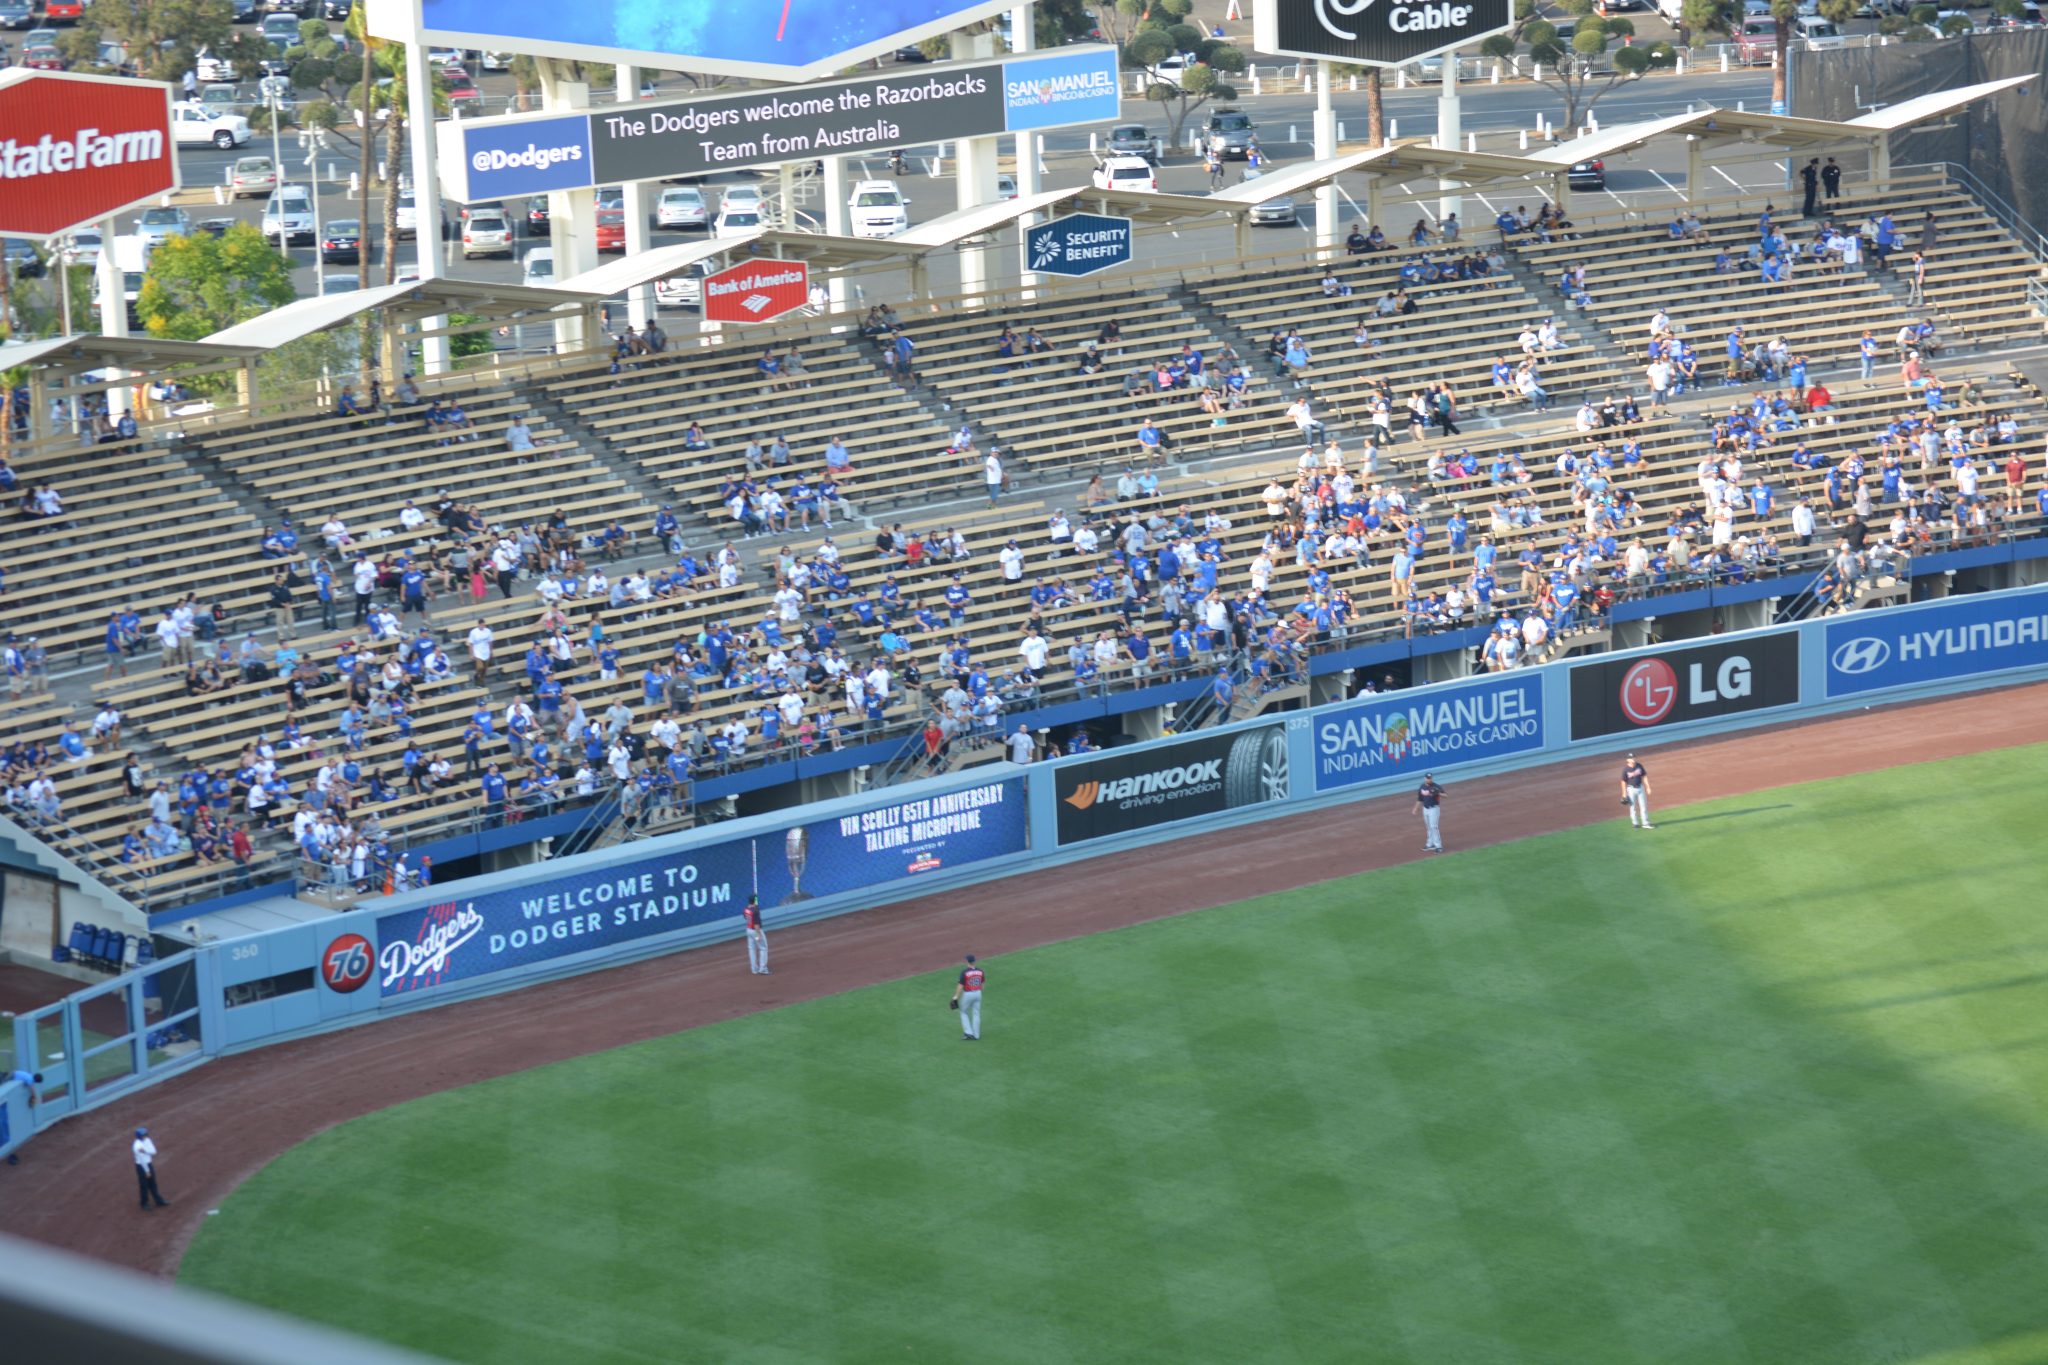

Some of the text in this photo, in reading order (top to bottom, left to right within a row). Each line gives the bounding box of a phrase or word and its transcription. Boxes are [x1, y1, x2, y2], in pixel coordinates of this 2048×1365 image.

[1388, 2, 1468, 33] Cable
[605, 73, 987, 139] The Dodgers welcome the Razorbacks
[1007, 71, 1114, 98] SAN MANUEL
[1008, 96, 1040, 108] INDIAN
[1051, 91, 1078, 103] BINGO
[1086, 86, 1115, 98] CASINO
[472, 144, 583, 172] @Dodgers
[699, 119, 900, 163] Team from Australia
[1066, 228, 1127, 246] SECURITY
[708, 270, 803, 296] Bank of America
[1900, 614, 2048, 662] HYUNDAI
[1689, 655, 1752, 705] LG
[1289, 717, 1310, 731] 375
[1320, 688, 1537, 755] SAN MANUEL
[1323, 718, 1538, 775] INDIAN BINGO & CASINO
[839, 783, 1004, 837] VIN SCULLY 65TH ANNIVERSARY
[1119, 781, 1222, 810] driving emotion
[864, 809, 982, 853] TALKING MICROPHONE
[521, 864, 699, 920] WELCOME TO
[489, 883, 731, 955] DODGER STADIUM
[231, 944, 259, 961] 360
[328, 942, 369, 984] 76
[379, 902, 485, 988] Dodgers
